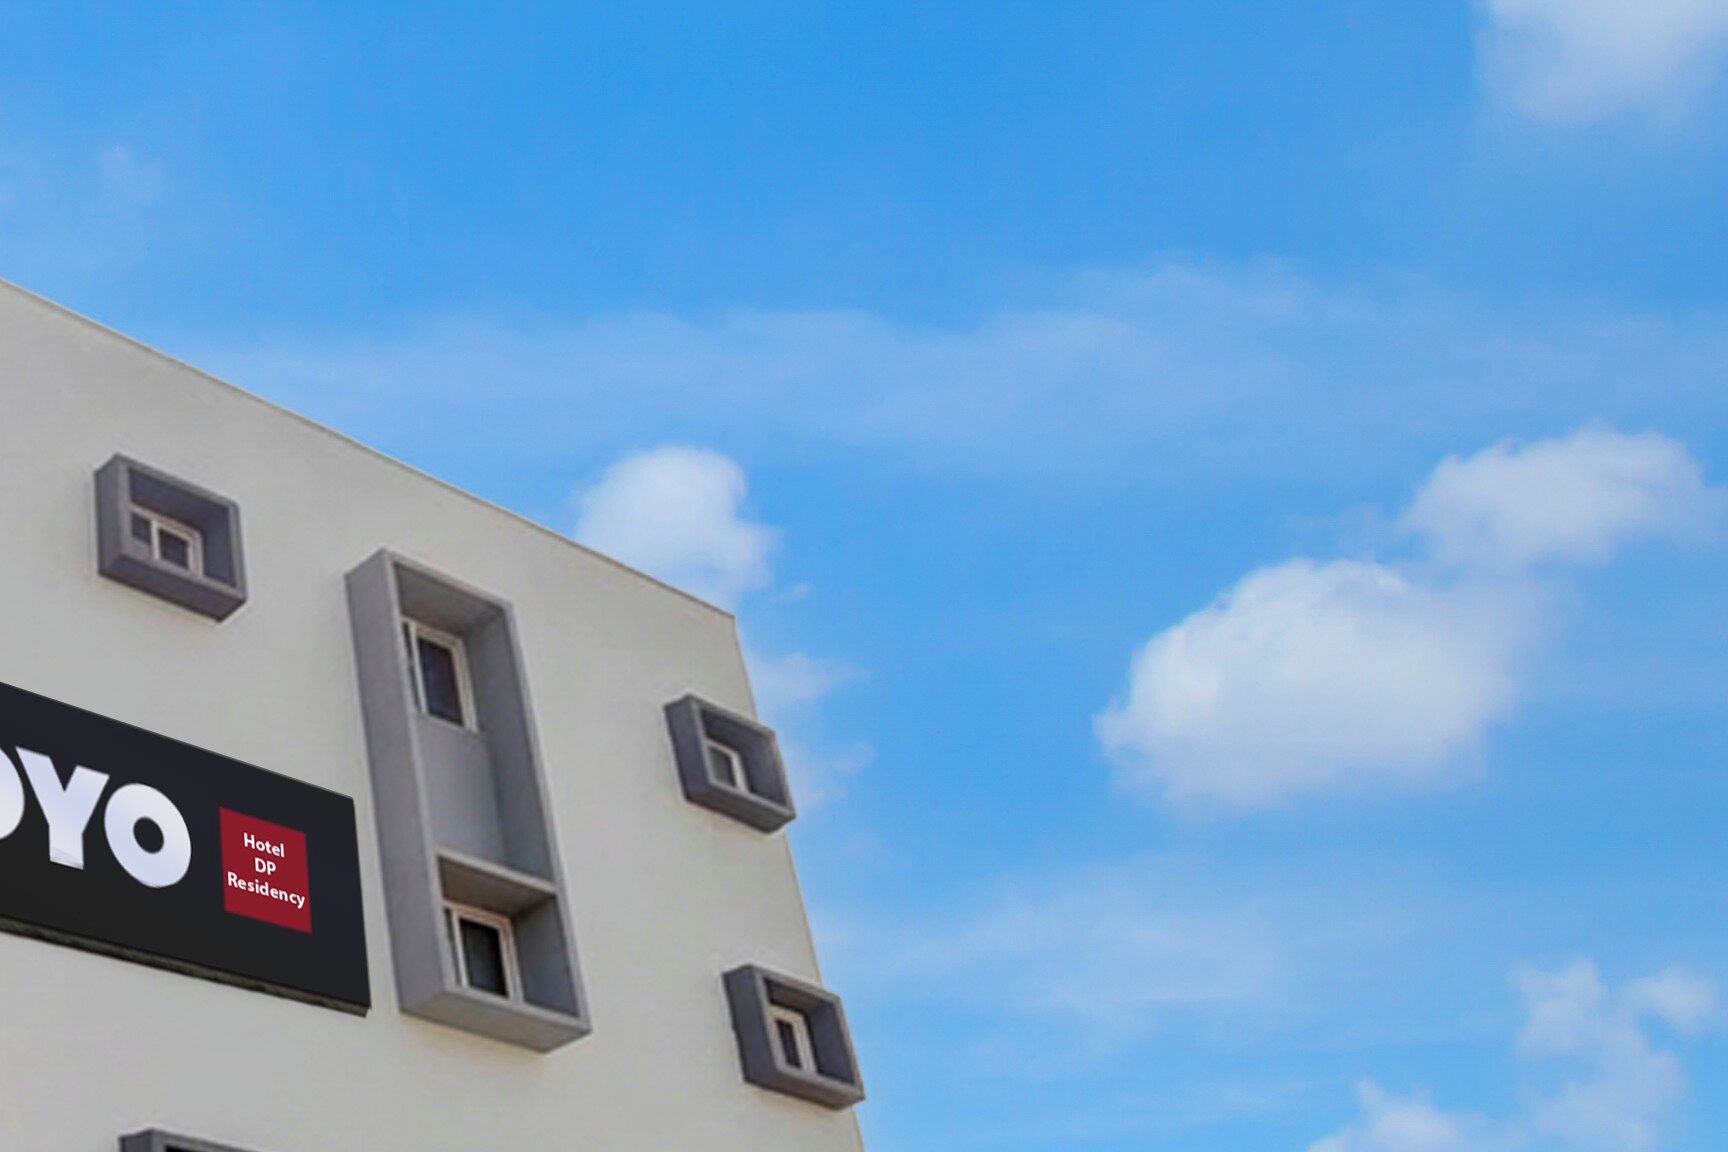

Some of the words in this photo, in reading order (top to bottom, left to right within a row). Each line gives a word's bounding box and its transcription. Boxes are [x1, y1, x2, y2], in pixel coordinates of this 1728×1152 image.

[243, 832, 285, 858] Hotel
[254, 857, 277, 875] DP
[227, 871, 306, 909] Residency
